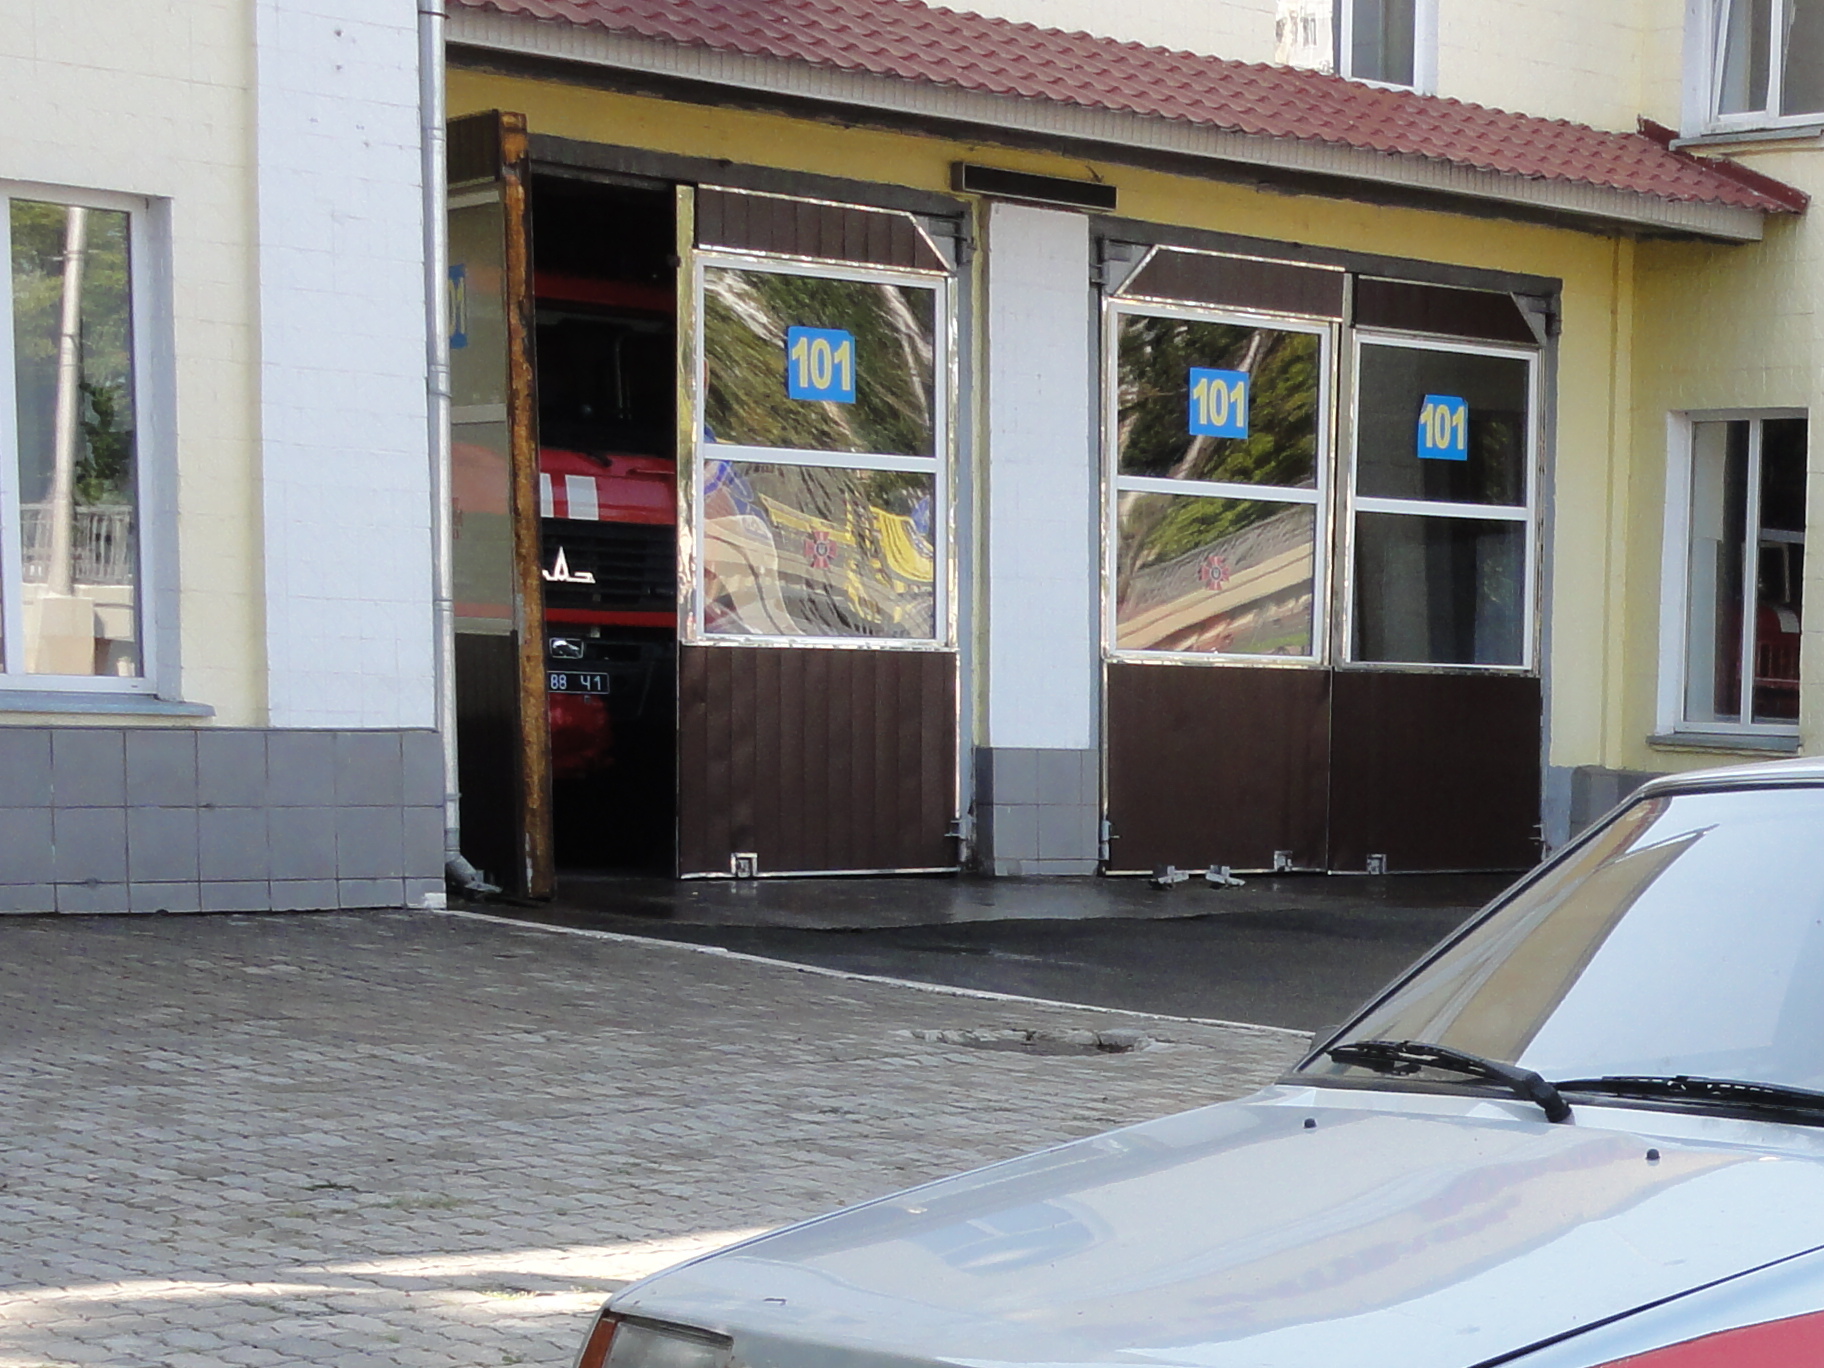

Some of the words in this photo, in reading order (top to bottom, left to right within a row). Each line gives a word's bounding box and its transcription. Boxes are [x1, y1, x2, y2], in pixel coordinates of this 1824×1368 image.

[448, 277, 465, 337] 01
[792, 337, 851, 391] 101
[1193, 378, 1245, 428] 101
[1421, 403, 1466, 450] 101
[550, 674, 567, 690] 88
